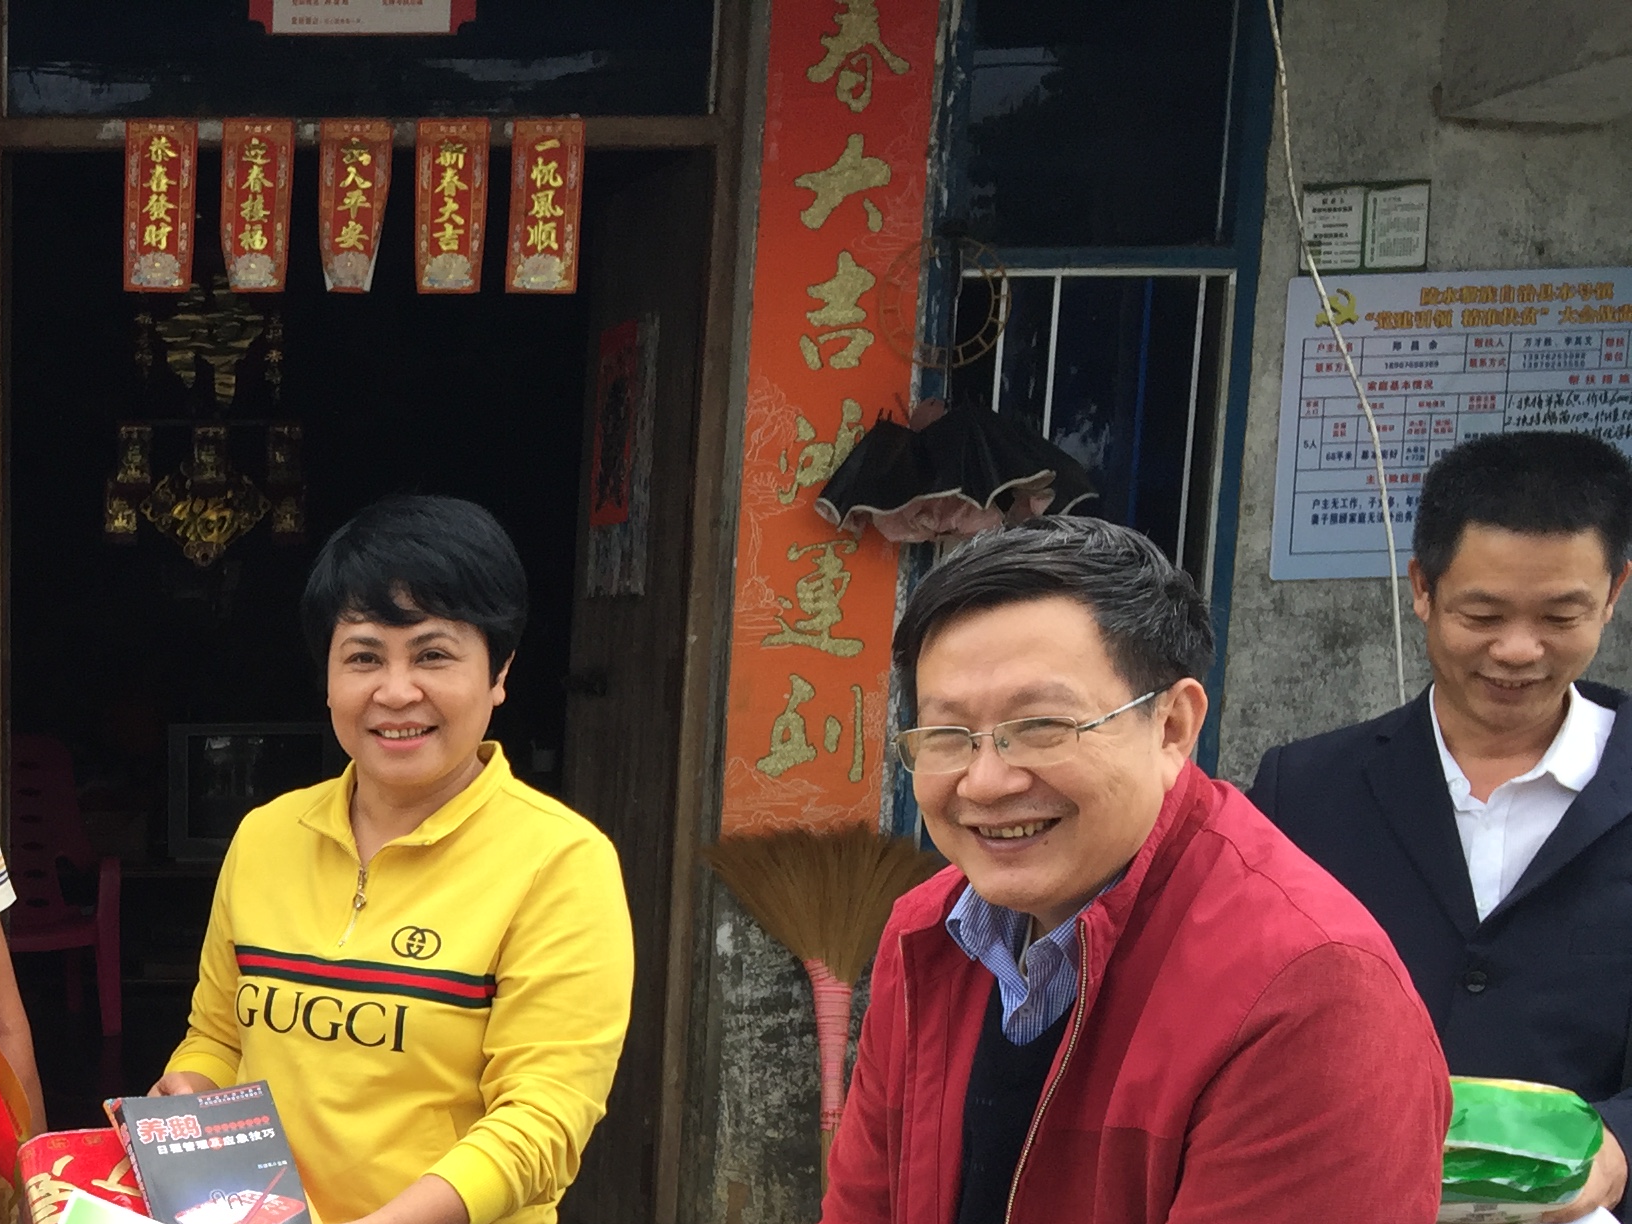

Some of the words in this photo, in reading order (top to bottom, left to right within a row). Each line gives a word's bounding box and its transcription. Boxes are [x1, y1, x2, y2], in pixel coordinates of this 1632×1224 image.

[433, 139, 469, 252] 新春大吉
[236, 983, 409, 1053] GUCCI
[137, 1114, 202, 1144] 养鹅
